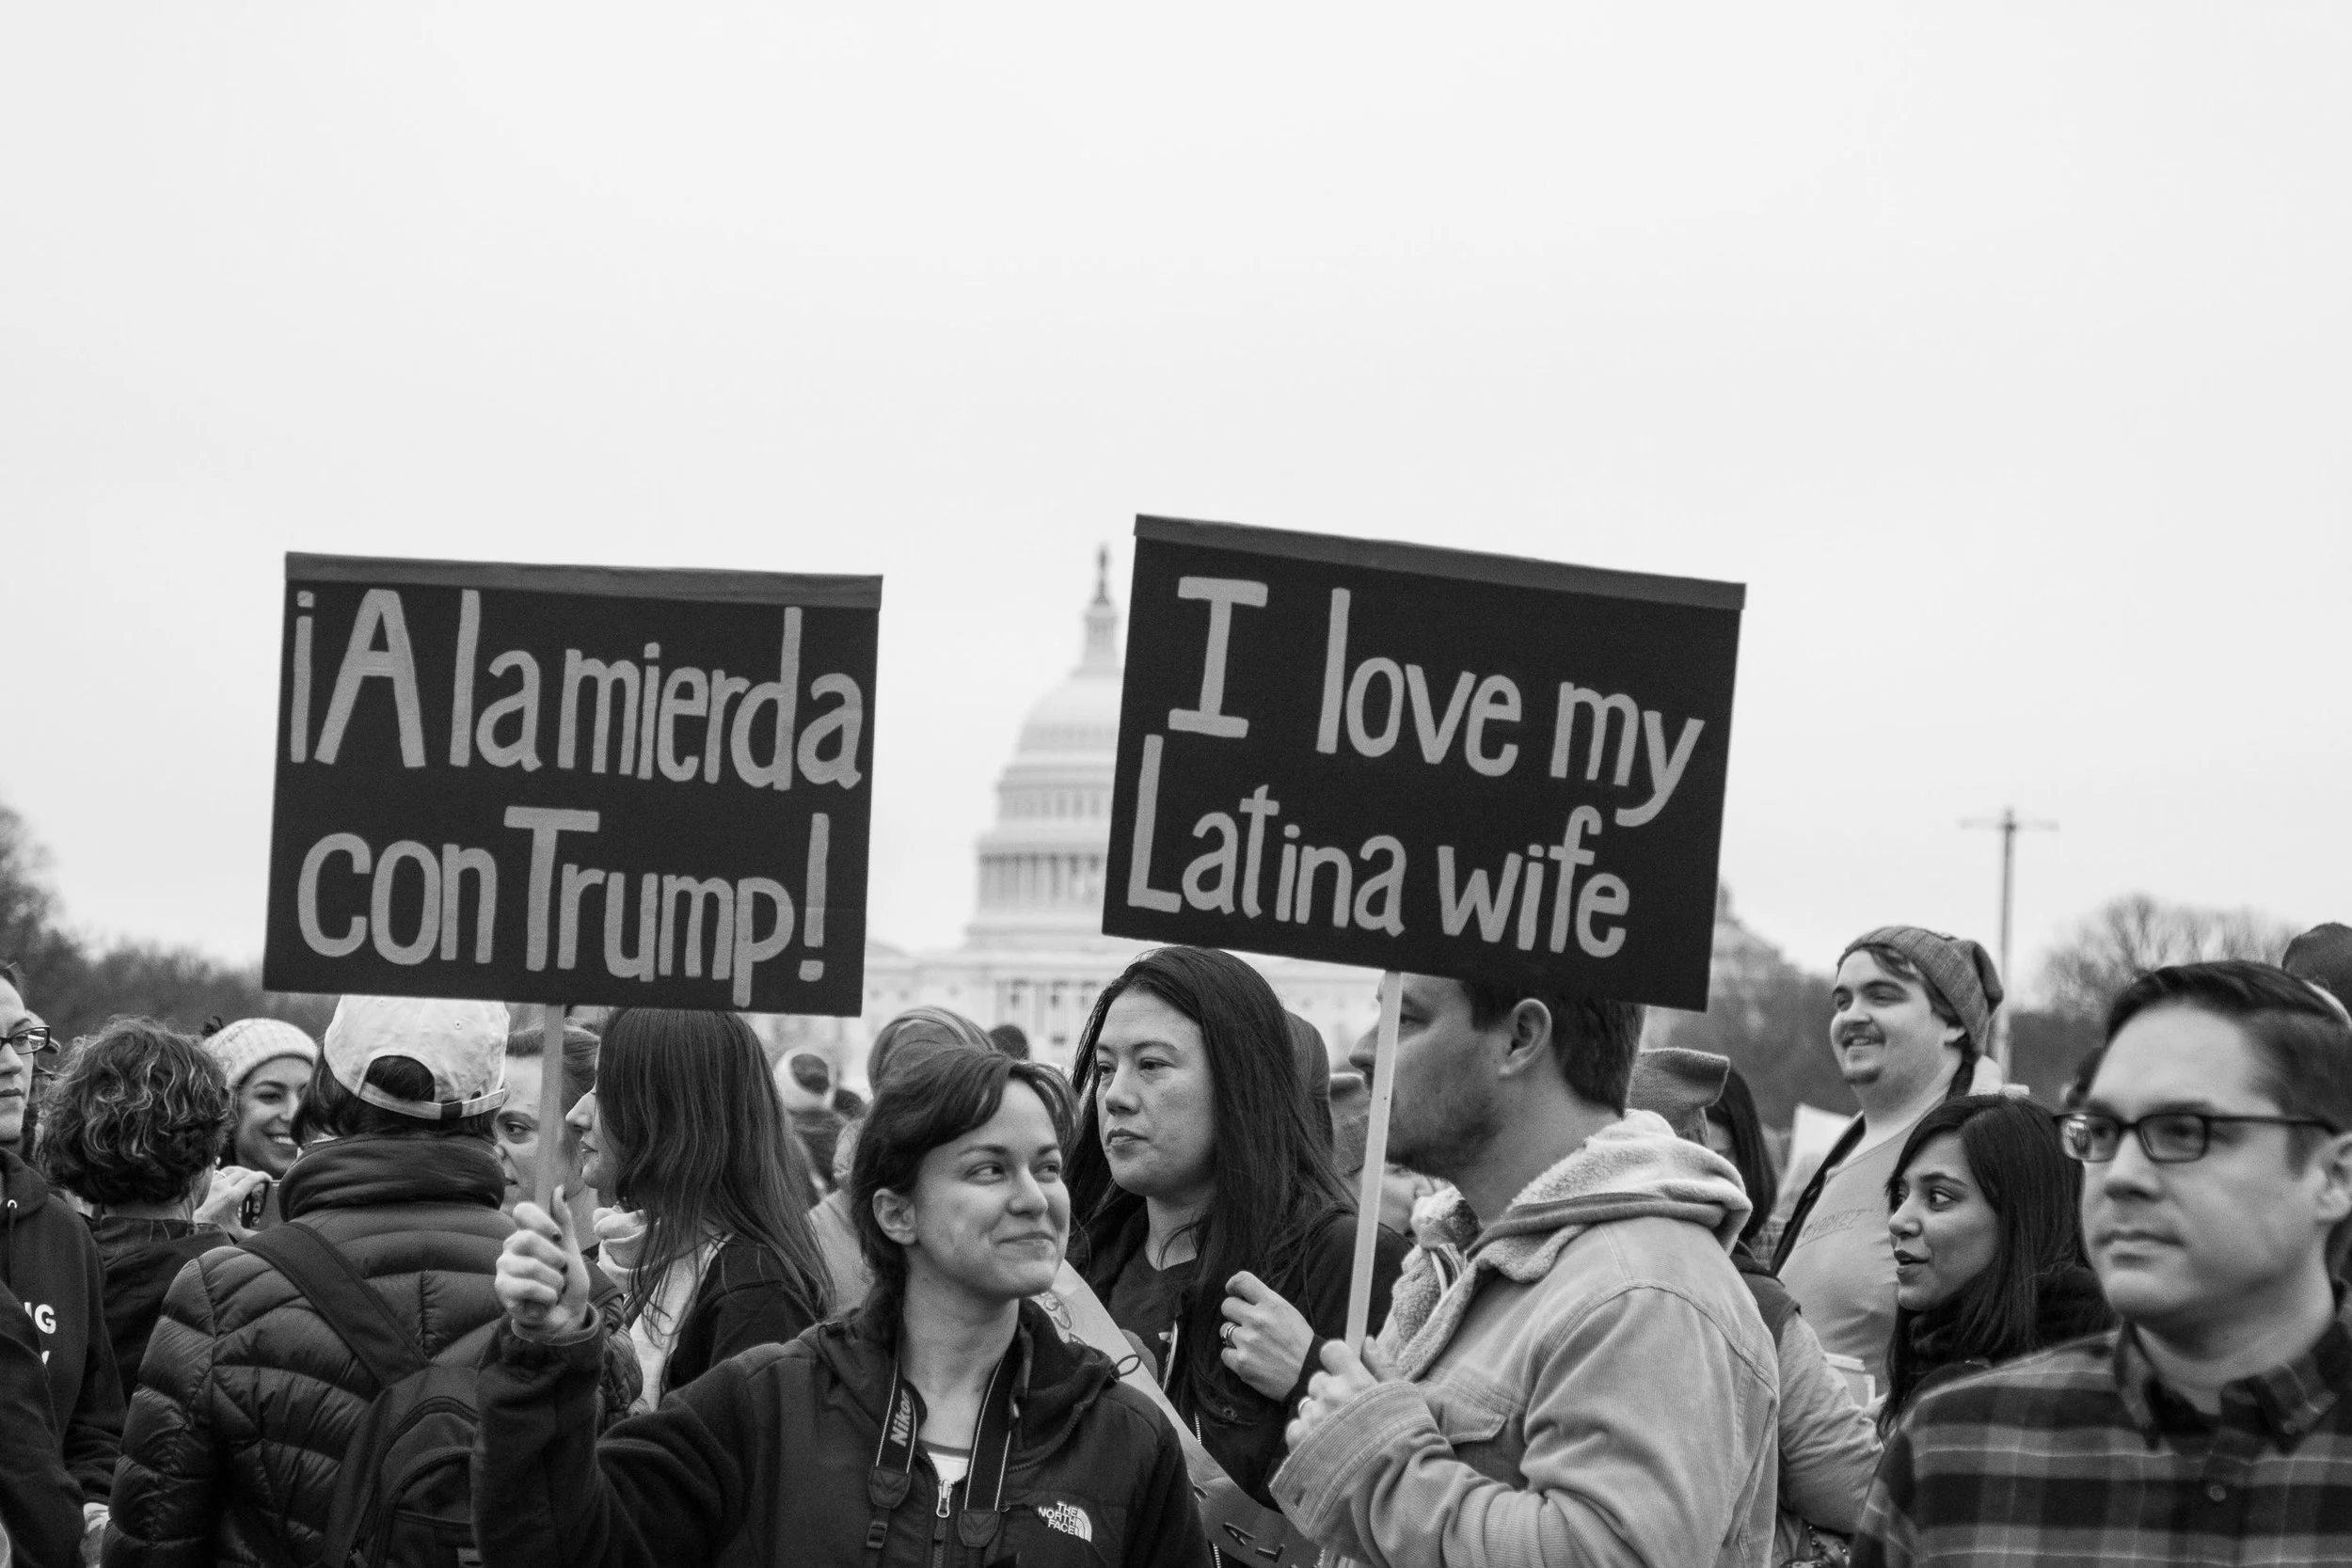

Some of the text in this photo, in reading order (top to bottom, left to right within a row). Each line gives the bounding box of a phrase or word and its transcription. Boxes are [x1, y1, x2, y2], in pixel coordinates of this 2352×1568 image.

[450, 590, 542, 771] la
[558, 607, 863, 790] mierda
[1168, 576, 1706, 827] I love my
[298, 806, 830, 1008] con Trump!
[1127, 734, 1630, 958] Latina wife
[1038, 1506, 1076, 1526] NORTH
[1048, 1518, 1075, 1535] FACE
[1057, 1501, 1078, 1517] THE
